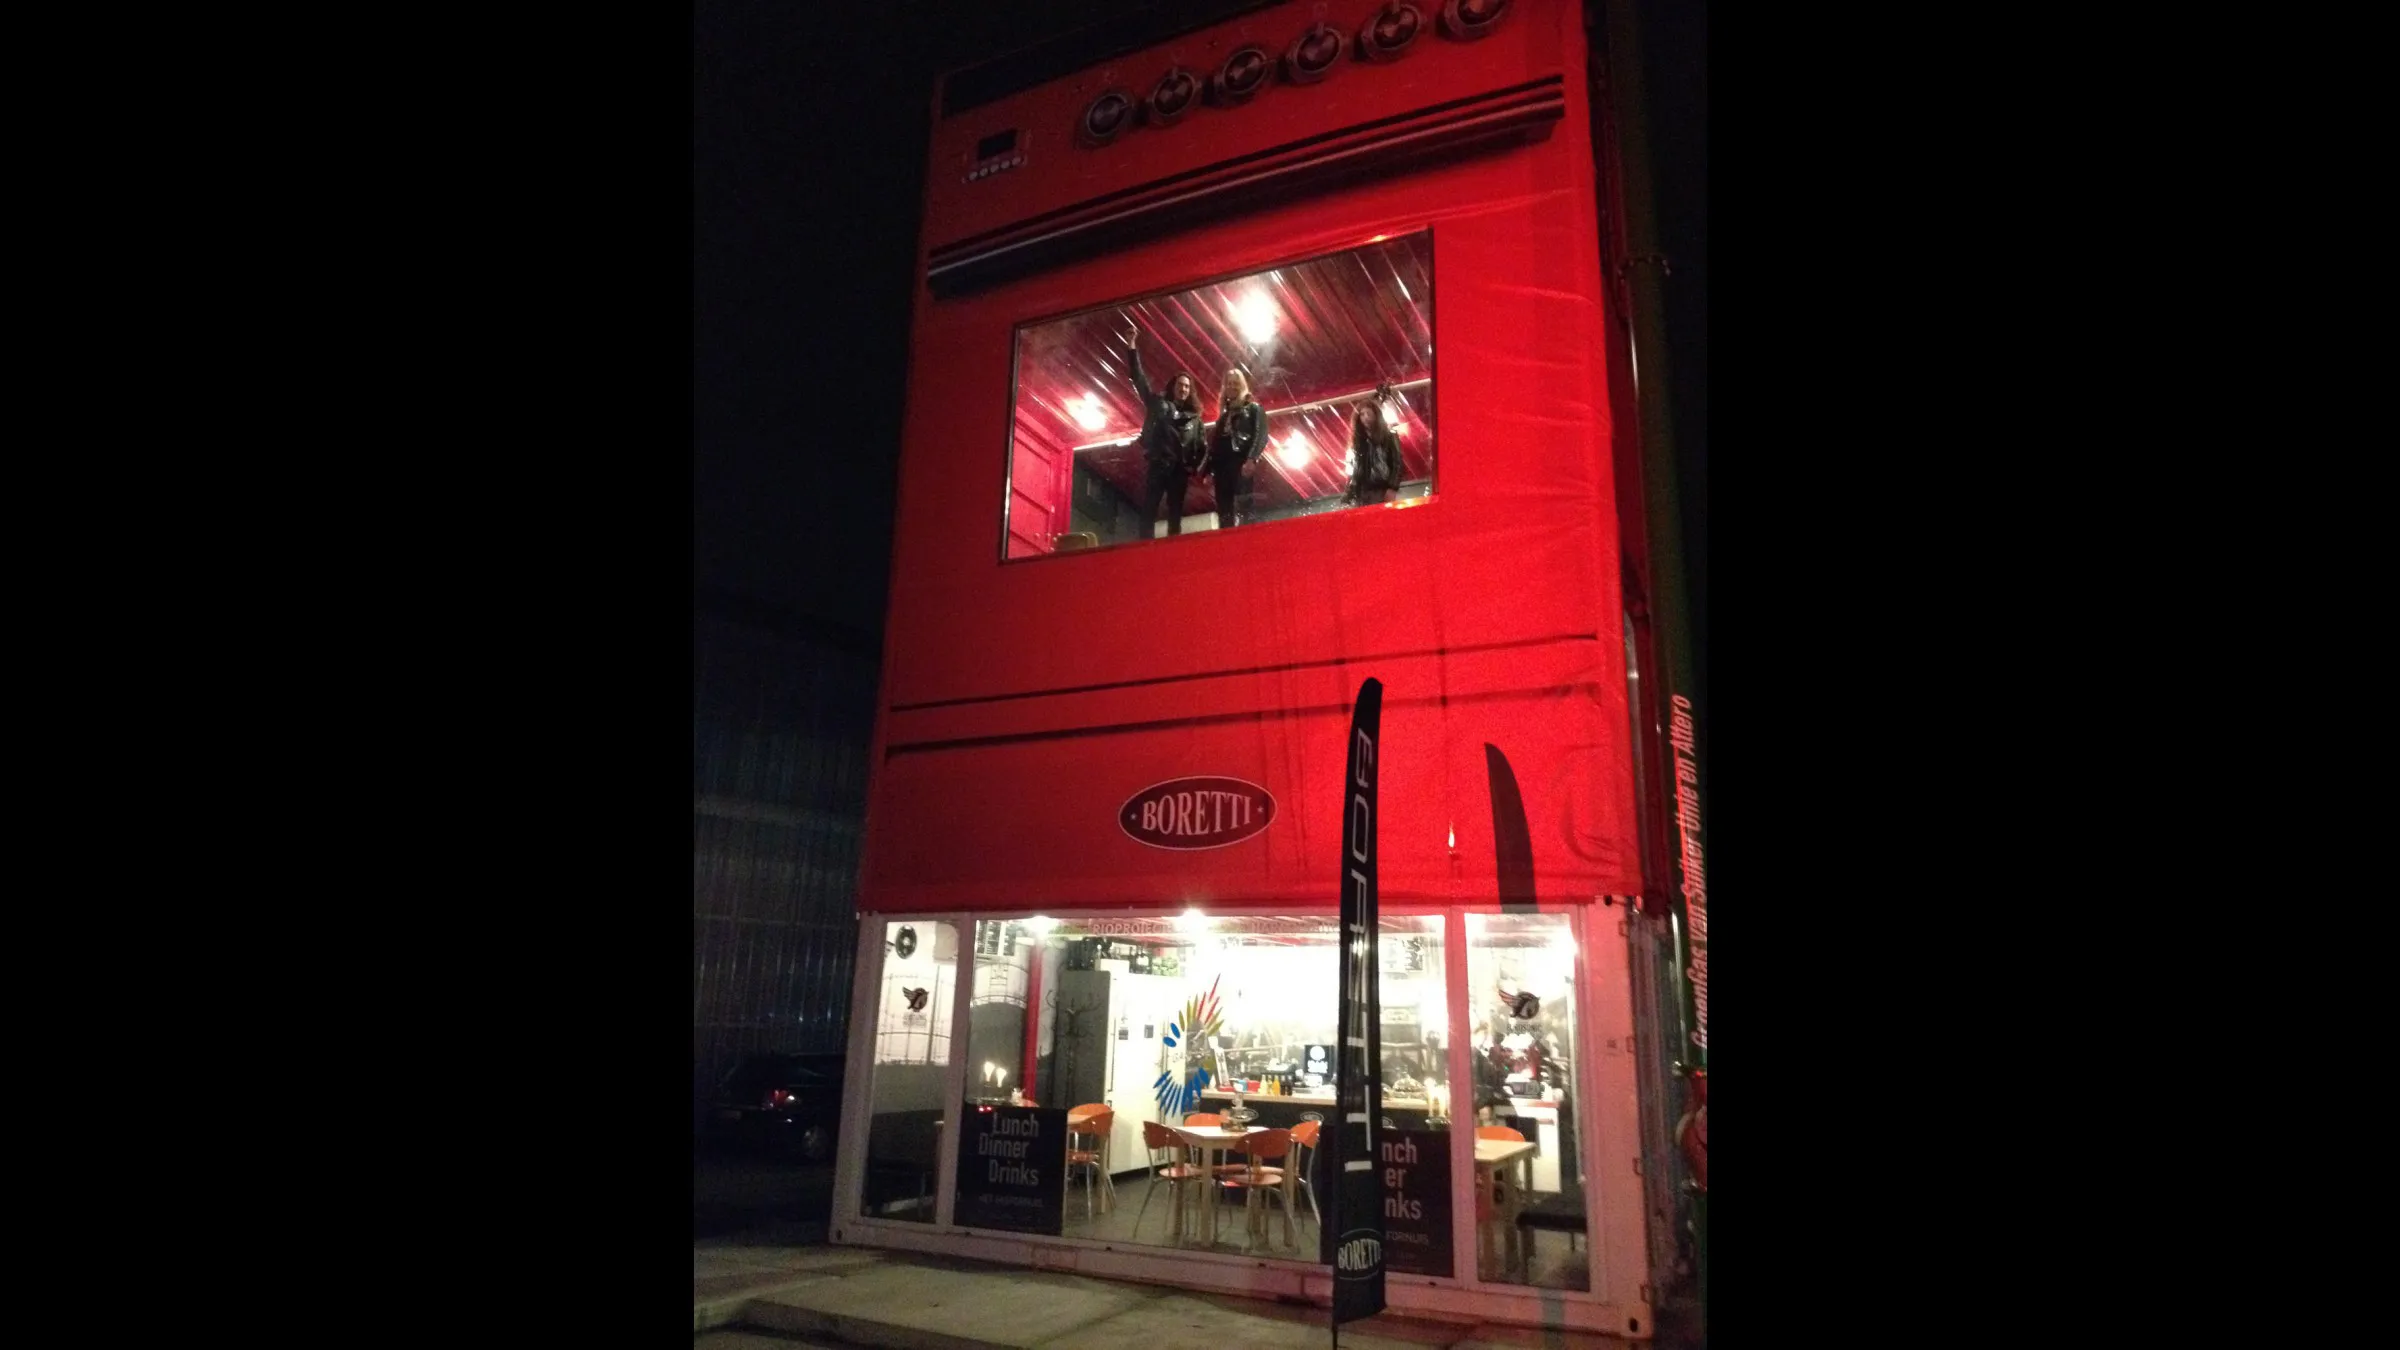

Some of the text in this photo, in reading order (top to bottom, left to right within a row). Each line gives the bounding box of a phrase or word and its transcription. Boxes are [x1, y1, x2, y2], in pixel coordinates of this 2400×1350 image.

[1669, 693, 1695, 757] Attero
[1679, 757, 1698, 784] en
[1142, 791, 1252, 836] BORETTI
[1673, 786, 1701, 832] Unie
[1678, 838, 1707, 904] Suiker
[993, 1112, 1039, 1137] Lunch
[979, 1133, 1030, 1158] Dinner
[1381, 1136, 1418, 1164] nch
[989, 1160, 1039, 1186] Drinks
[1384, 1192, 1422, 1220] nks
